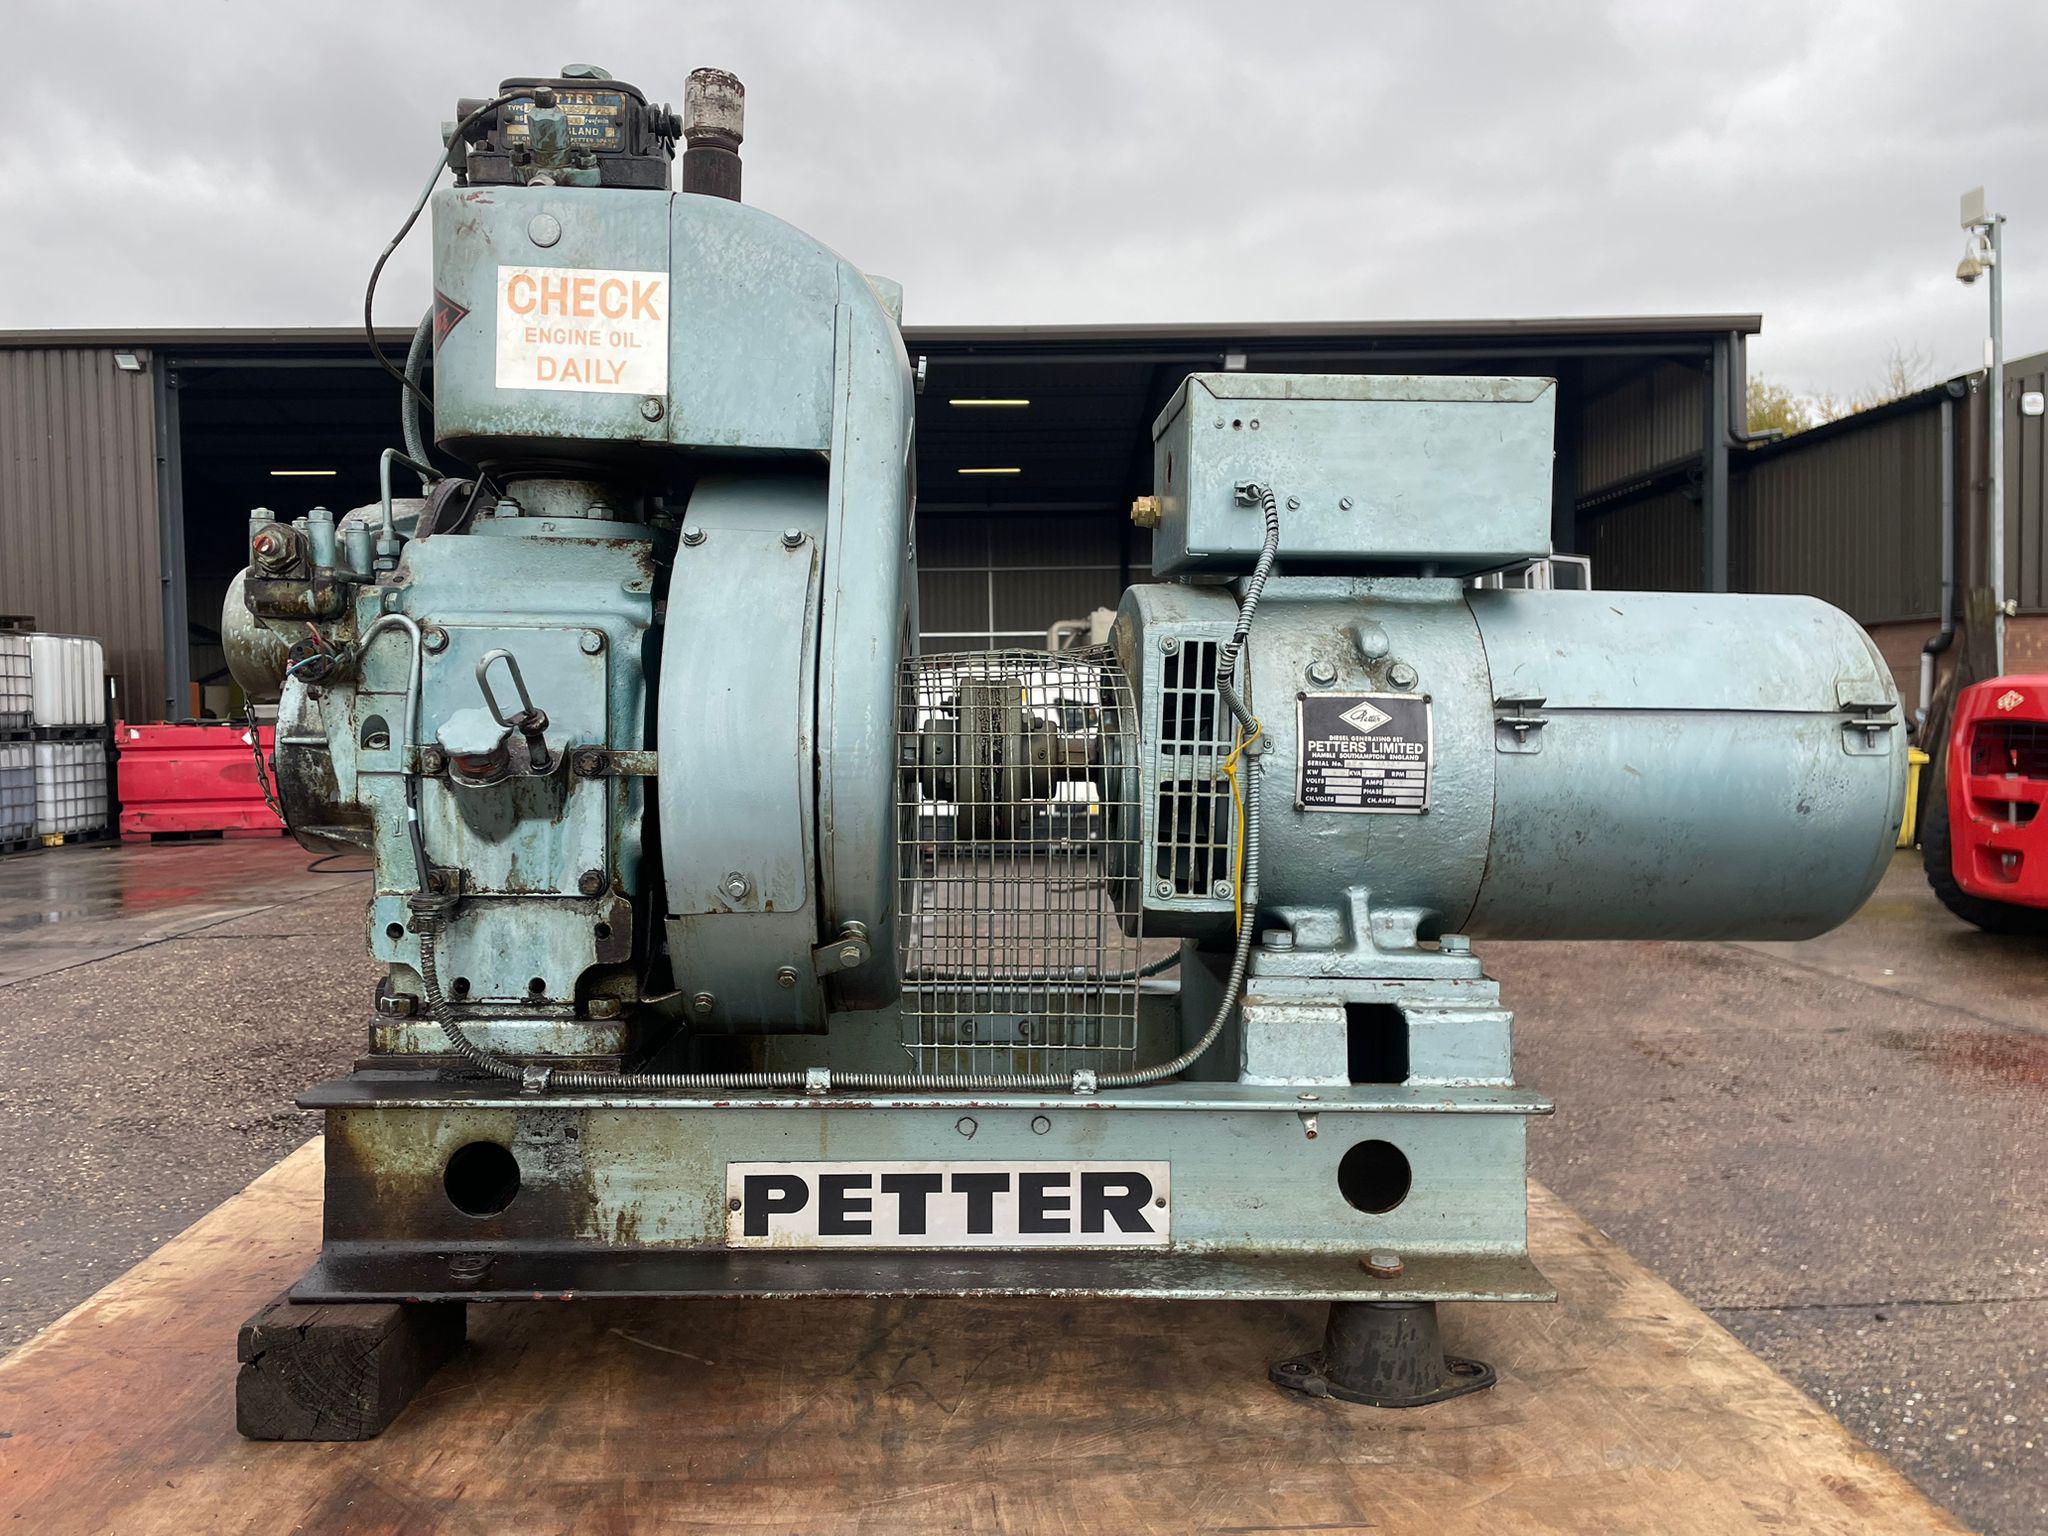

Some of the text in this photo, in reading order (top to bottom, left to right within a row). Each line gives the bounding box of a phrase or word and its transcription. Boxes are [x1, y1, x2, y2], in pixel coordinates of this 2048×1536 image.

[553, 93, 593, 104] TTER
[507, 274, 662, 321] CHECK
[525, 327, 642, 348] ENGINE OIL
[536, 356, 628, 385] DAILY
[1308, 741, 1424, 754] PETTERS LIMITED
[744, 1171, 1156, 1237] PETTER
